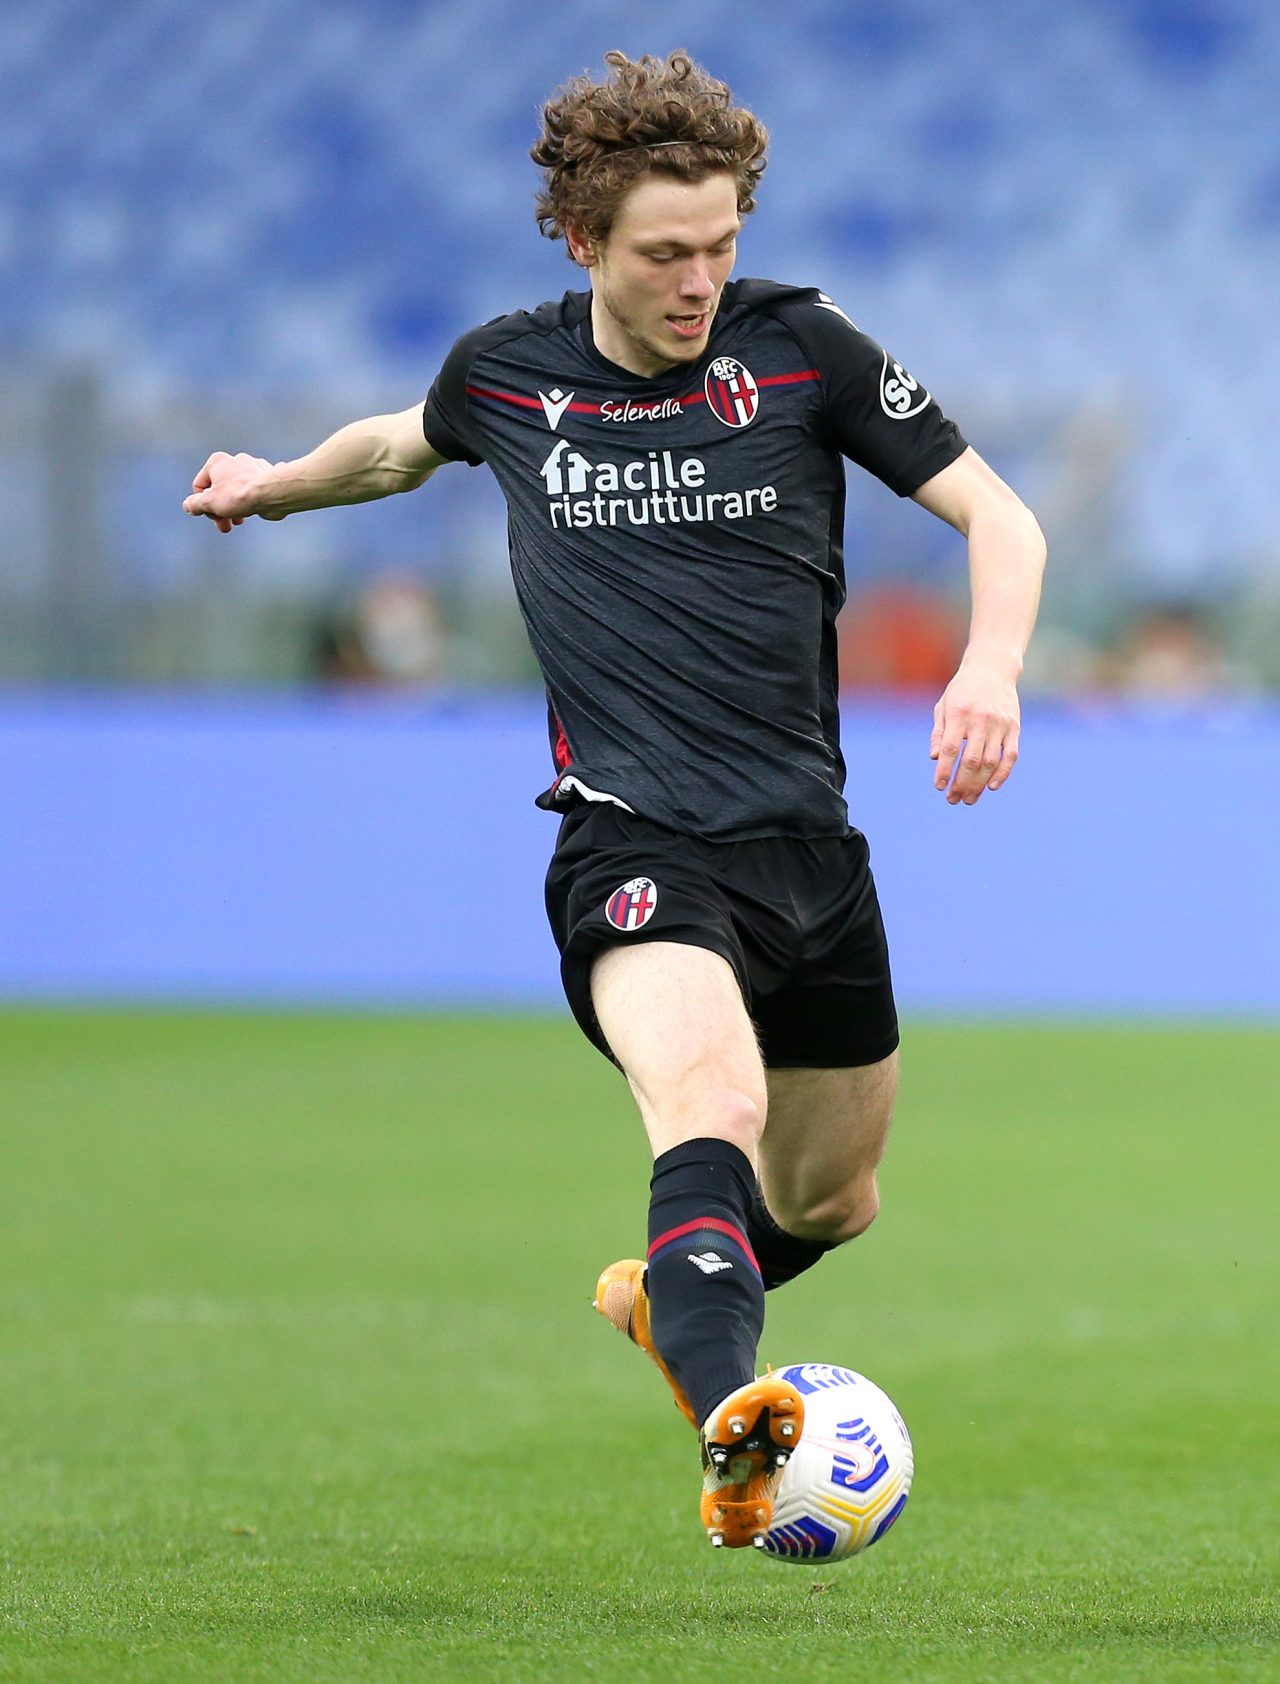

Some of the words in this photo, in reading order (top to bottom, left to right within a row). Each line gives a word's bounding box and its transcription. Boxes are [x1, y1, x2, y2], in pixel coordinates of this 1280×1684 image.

[712, 360, 738, 377] BFC
[600, 398, 684, 423] Selenella
[540, 439, 706, 495] facile
[550, 486, 778, 529] ristrutturare
